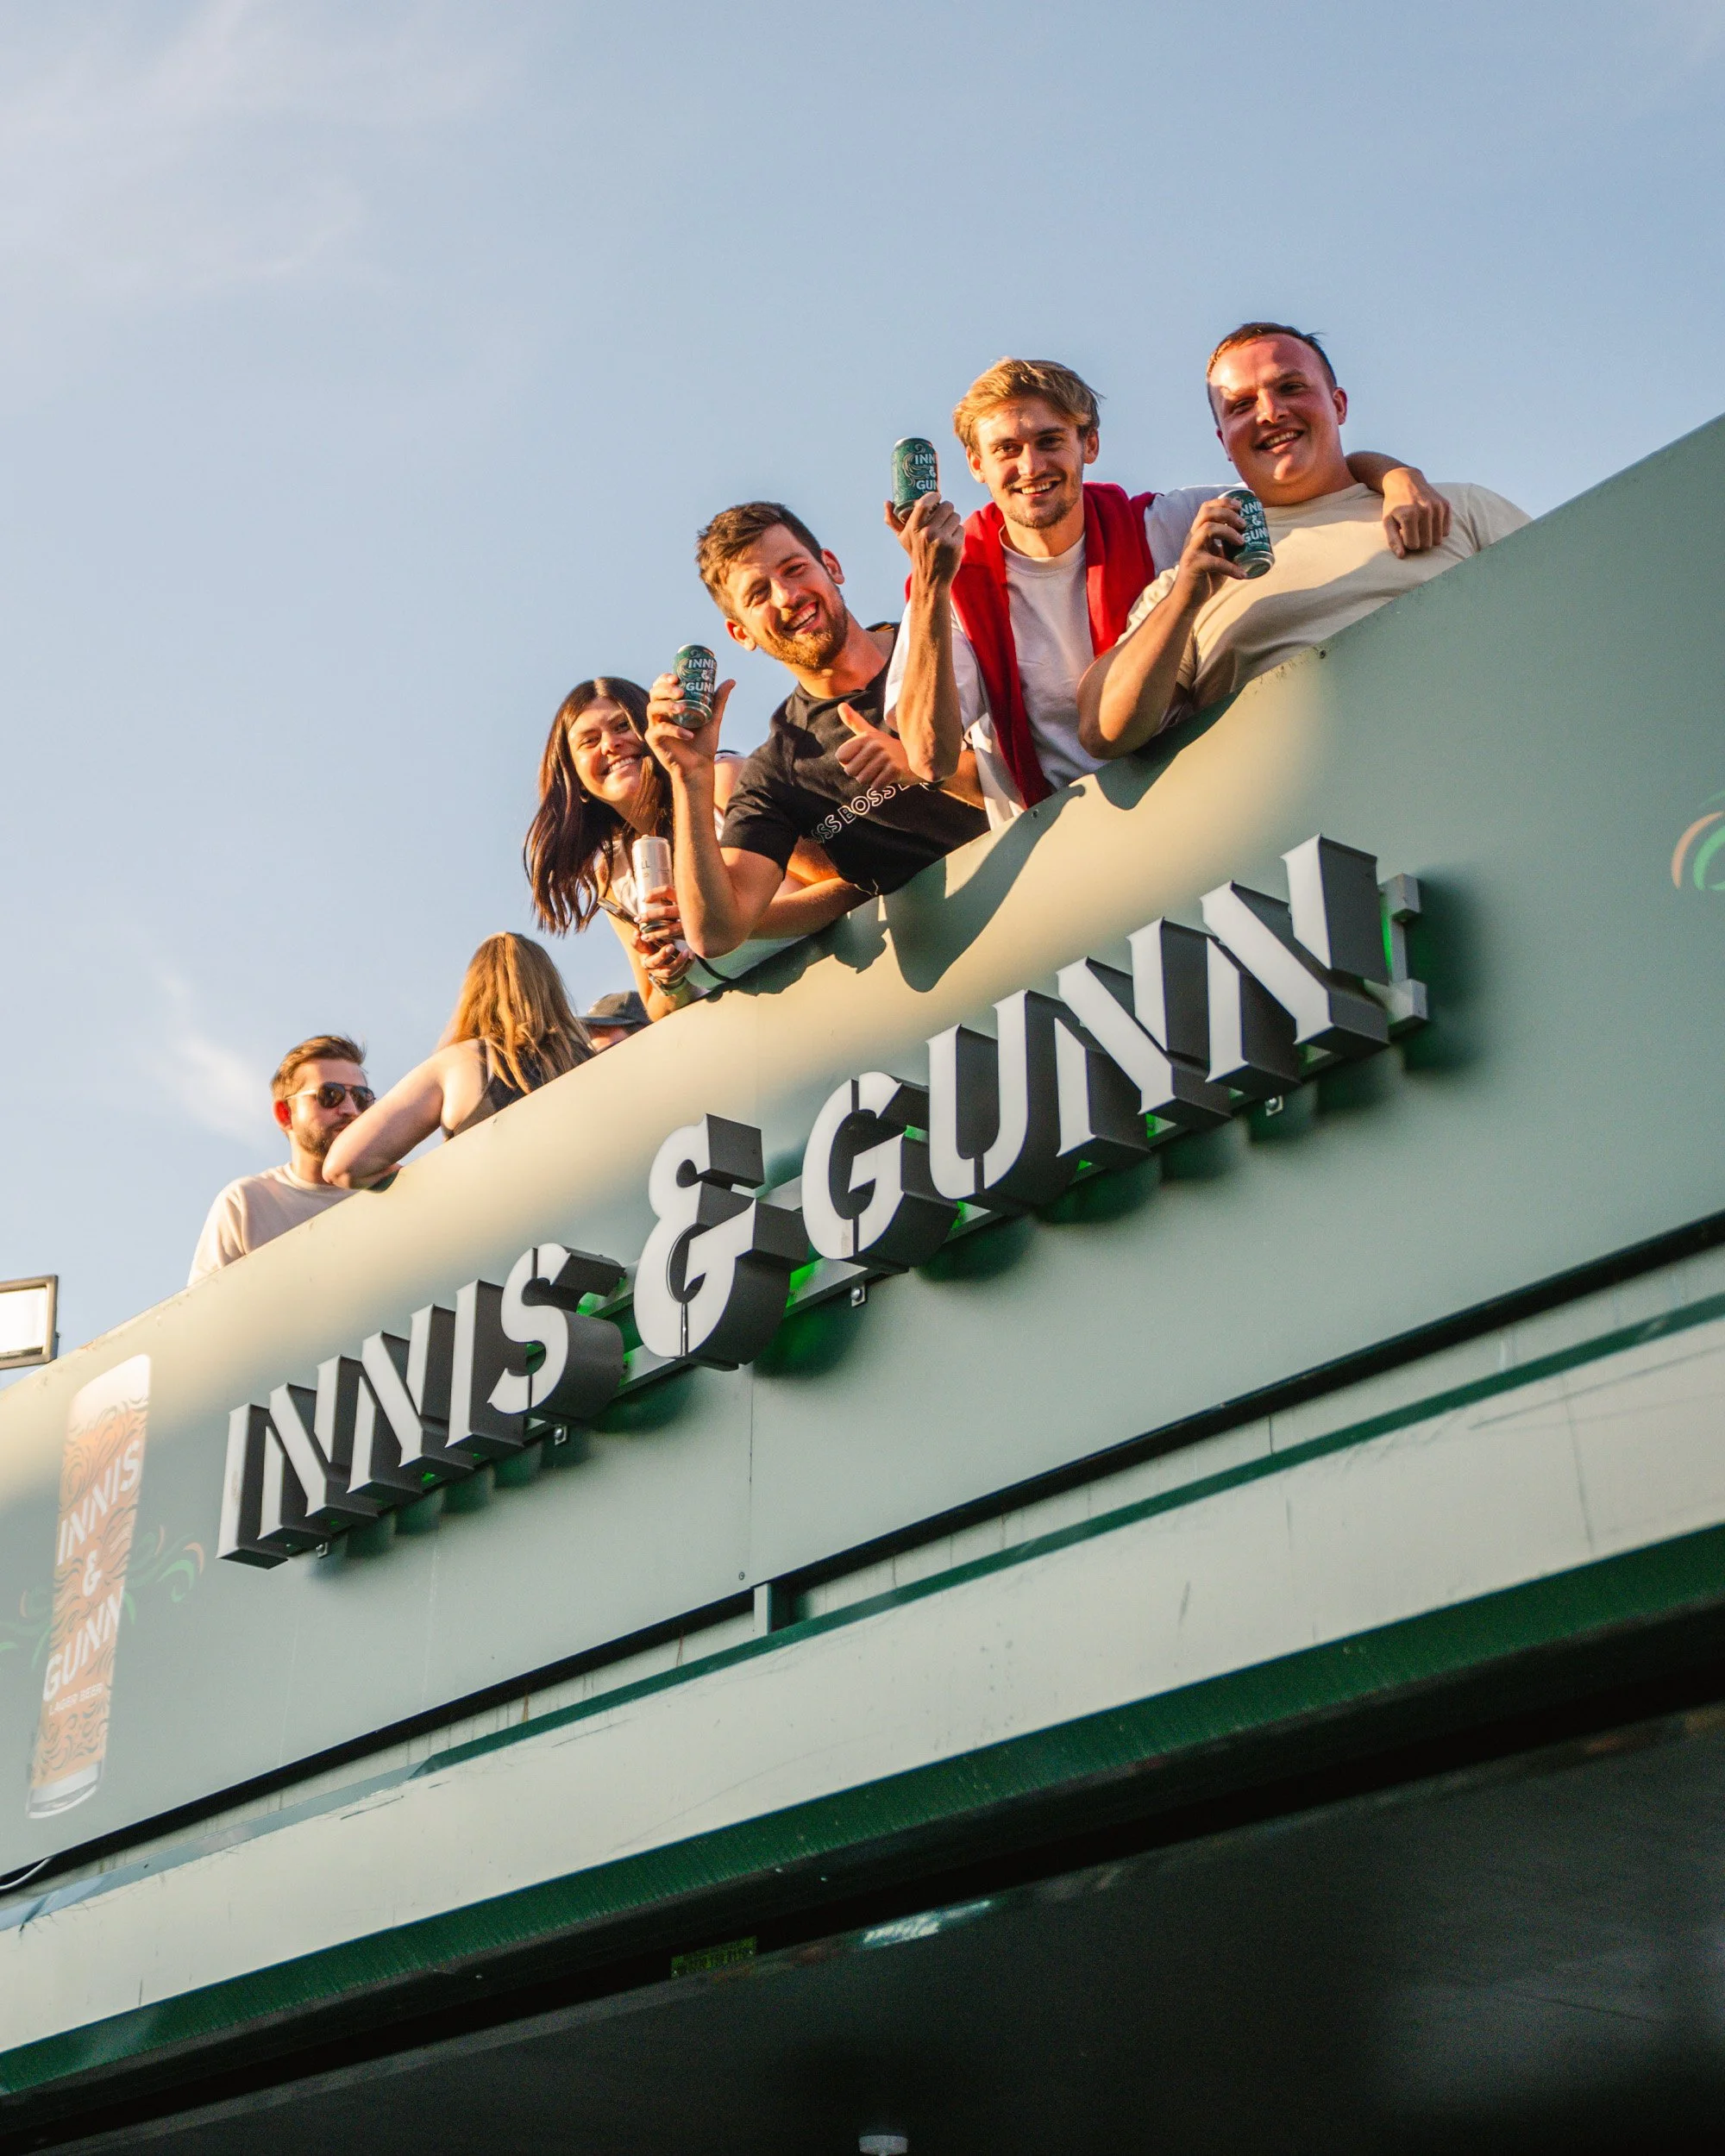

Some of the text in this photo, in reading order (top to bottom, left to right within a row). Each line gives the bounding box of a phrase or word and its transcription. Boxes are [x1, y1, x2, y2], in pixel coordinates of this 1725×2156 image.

[1251, 514, 1261, 526] &
[216, 833, 1336, 1560] INNIS & GUNN
[56, 1439, 141, 1566] INNIS
[82, 1549, 102, 1597] &
[42, 1584, 124, 1702] GUNN
